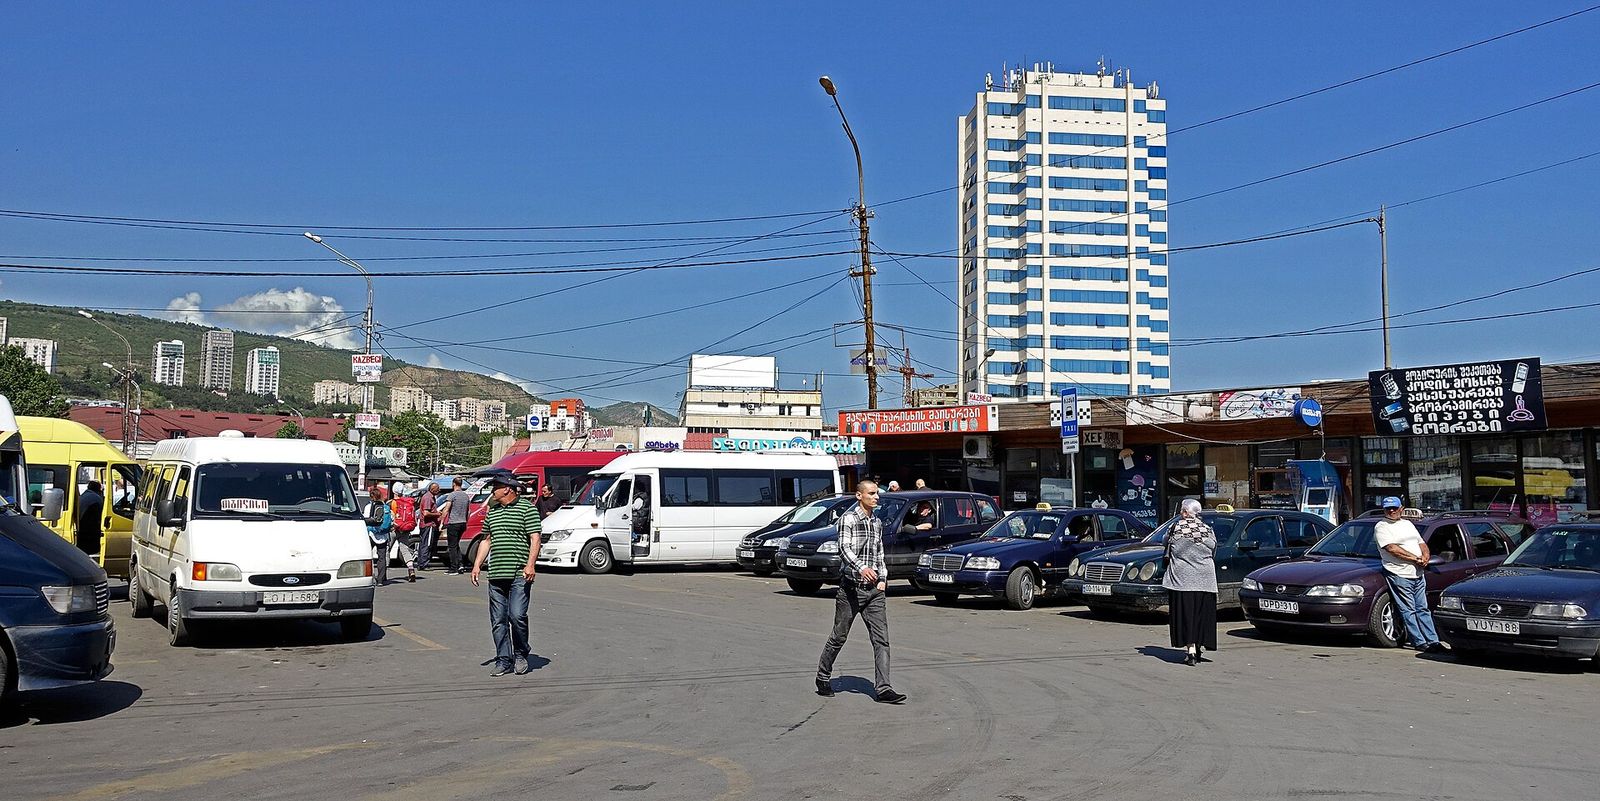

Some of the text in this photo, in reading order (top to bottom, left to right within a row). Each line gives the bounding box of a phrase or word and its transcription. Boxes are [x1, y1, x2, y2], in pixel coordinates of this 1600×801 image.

[353, 356, 381, 364] KAZBEGI
[1405, 364, 1502, 381] მობილურის შეკეთება
[1407, 379, 1450, 391] კოდის
[1409, 397, 1504, 413] პროგრამირება
[846, 407, 981, 422] მაღალი ხარისხის მაისურები
[880, 420, 942, 433] თურქეთიდან
[1412, 419, 1502, 434] ნომრები
[645, 441, 679, 449] canbebe
[713, 439, 788, 450] აფთიაქი
[1473, 619, 1517, 633] YUY-188
